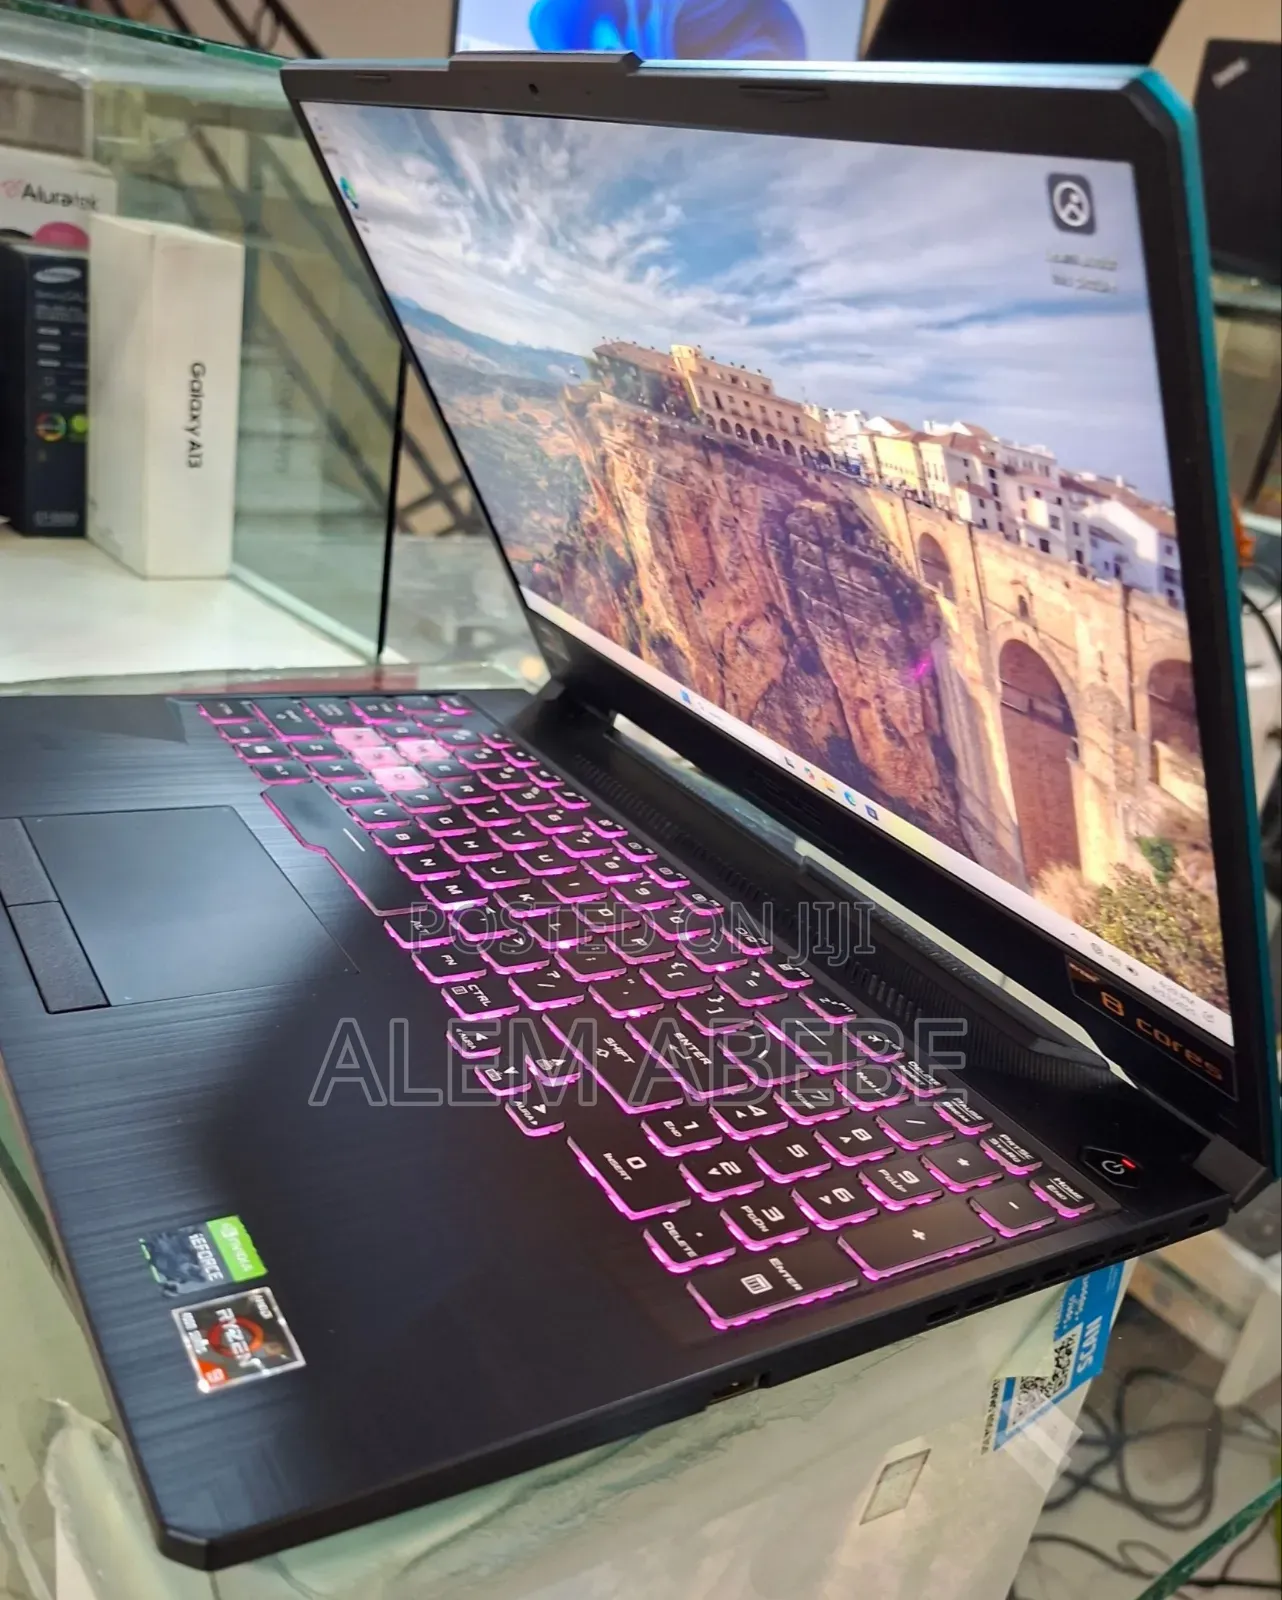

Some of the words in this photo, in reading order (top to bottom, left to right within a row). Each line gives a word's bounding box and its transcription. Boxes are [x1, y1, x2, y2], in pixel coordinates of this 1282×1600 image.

[184, 362, 206, 436] Galaxy
[186, 440, 203, 469] A13
[460, 785, 474, 793] R
[373, 808, 388, 816] V
[395, 833, 411, 841] B
[512, 830, 526, 838] Y
[463, 840, 479, 849] H
[420, 858, 437, 867] N
[538, 854, 554, 863] U
[490, 866, 507, 875] J
[445, 884, 463, 895] M
[518, 893, 535, 901] K
[410, 919, 430, 934] ALT
[631, 937, 647, 946] P
[441, 954, 458, 966] FN
[468, 984, 492, 1007] CTRL
[603, 1036, 636, 1064] SHIFT
[673, 1032, 713, 1066] ENTER
[1136, 1018, 1223, 1081] cores
[513, 1100, 534, 1121] AURA
[747, 1104, 768, 1117] 4
[683, 1120, 700, 1130] 1
[851, 1128, 873, 1142] 8
[786, 1144, 809, 1158] 5
[603, 1152, 633, 1181] INSERT
[626, 1156, 648, 1170] 0
[719, 1160, 742, 1176] 2
[897, 1170, 920, 1184] 9
[832, 1187, 856, 1203] 6
[761, 1206, 786, 1222] 3
[662, 1220, 699, 1259] DELETE
[768, 1257, 804, 1292] ENTER
[214, 1306, 259, 1369] RYZEN
